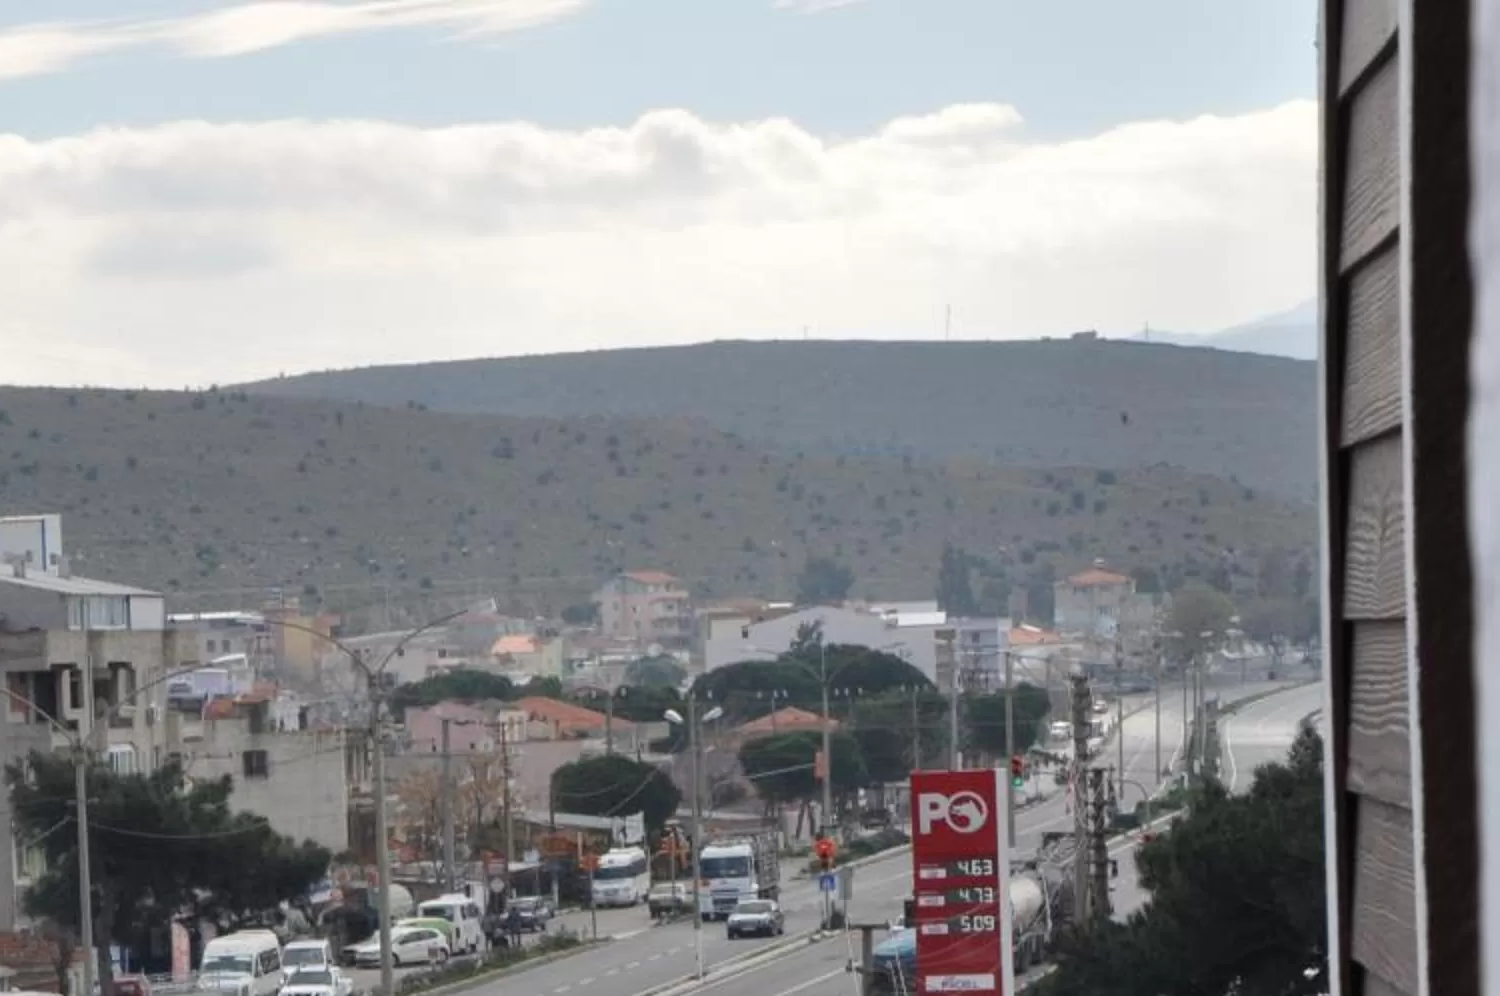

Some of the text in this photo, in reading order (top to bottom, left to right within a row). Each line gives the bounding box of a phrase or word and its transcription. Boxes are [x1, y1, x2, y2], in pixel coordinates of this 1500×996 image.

[957, 859, 993, 876] 4.63
[958, 888, 993, 904] 4.73
[960, 915, 995, 932] 5.09
